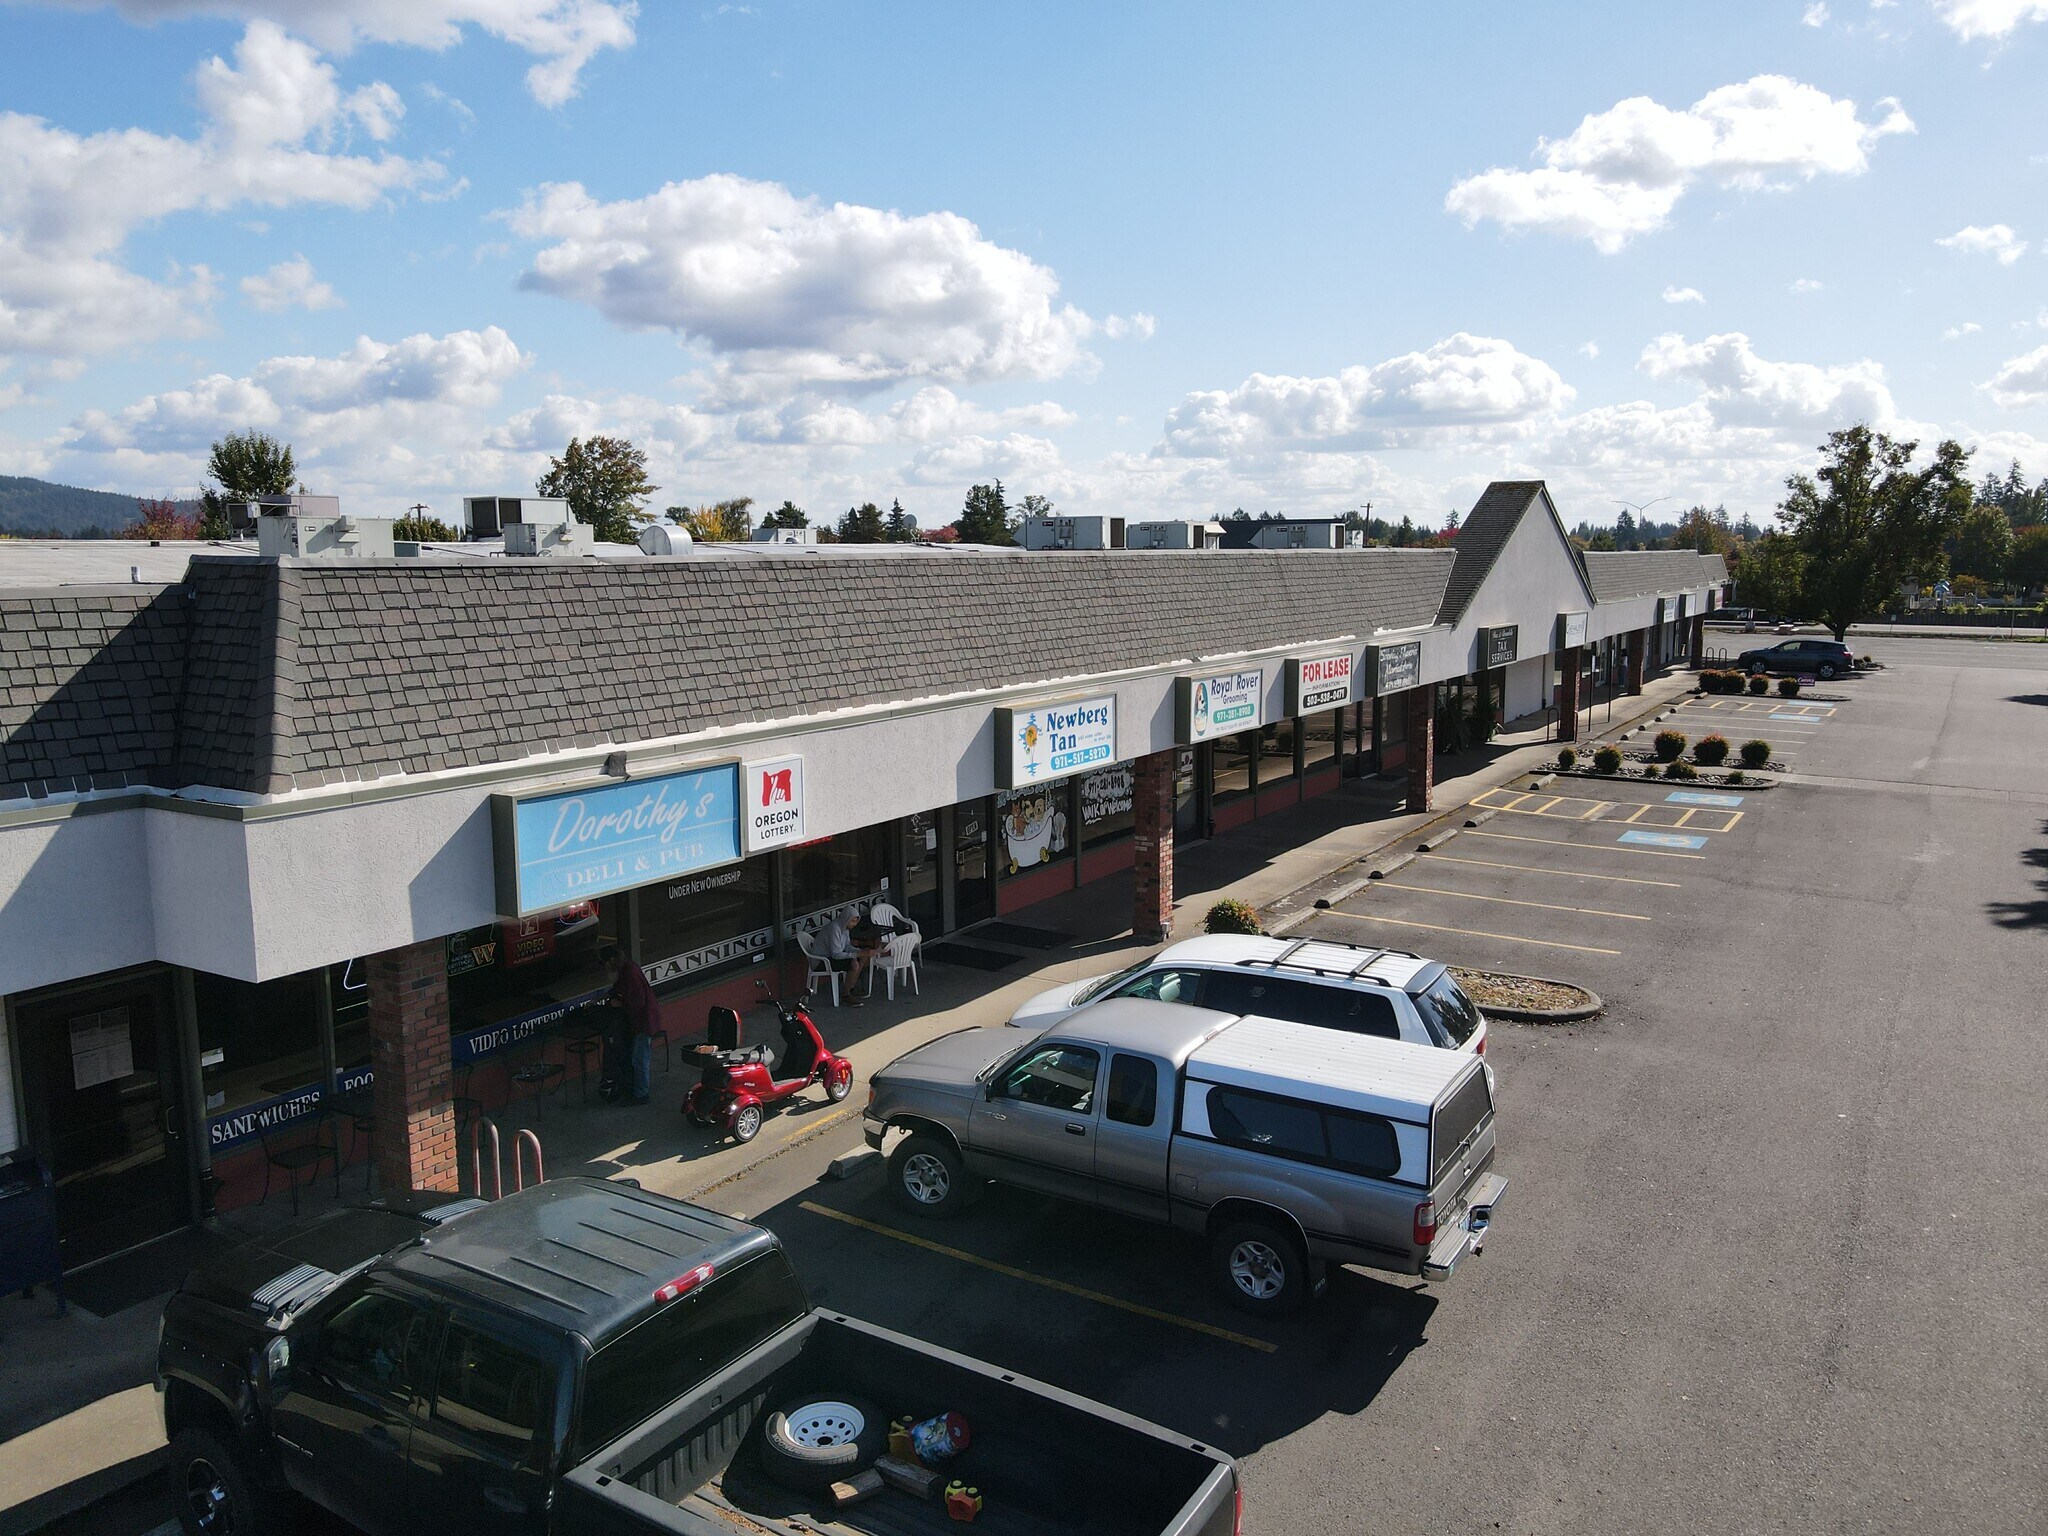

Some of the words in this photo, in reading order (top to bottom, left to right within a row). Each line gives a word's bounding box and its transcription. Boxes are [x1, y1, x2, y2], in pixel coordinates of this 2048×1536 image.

[1491, 650, 1513, 663] SERVICES
[1498, 641, 1507, 652] TAX
[1303, 663, 1321, 683] FOR
[1323, 658, 1349, 679] LEASE
[1211, 675, 1233, 697] Royal
[1236, 674, 1258, 690] Rover
[1312, 680, 1340, 691] INFORMATION
[1223, 691, 1247, 704] Grooming
[1046, 705, 1107, 732] Newberg
[1049, 733, 1076, 752] Tan
[548, 776, 714, 852] Dorothy's
[755, 808, 799, 828] OREGON
[761, 824, 794, 839] LOTTERY
[566, 861, 624, 888] DELI
[634, 856, 650, 870] &
[660, 842, 704, 865] PUB
[669, 885, 690, 899] UNDER
[690, 880, 706, 894] NEW
[706, 870, 741, 891] OWNERSHIP
[559, 899, 600, 921] OPEN
[787, 895, 887, 935] TANING
[517, 937, 545, 952] VIDEO
[645, 933, 767, 982] TANNING
[212, 1091, 321, 1144] SANDWICHES
[1436, 1197, 1457, 1227] TOYOTA
